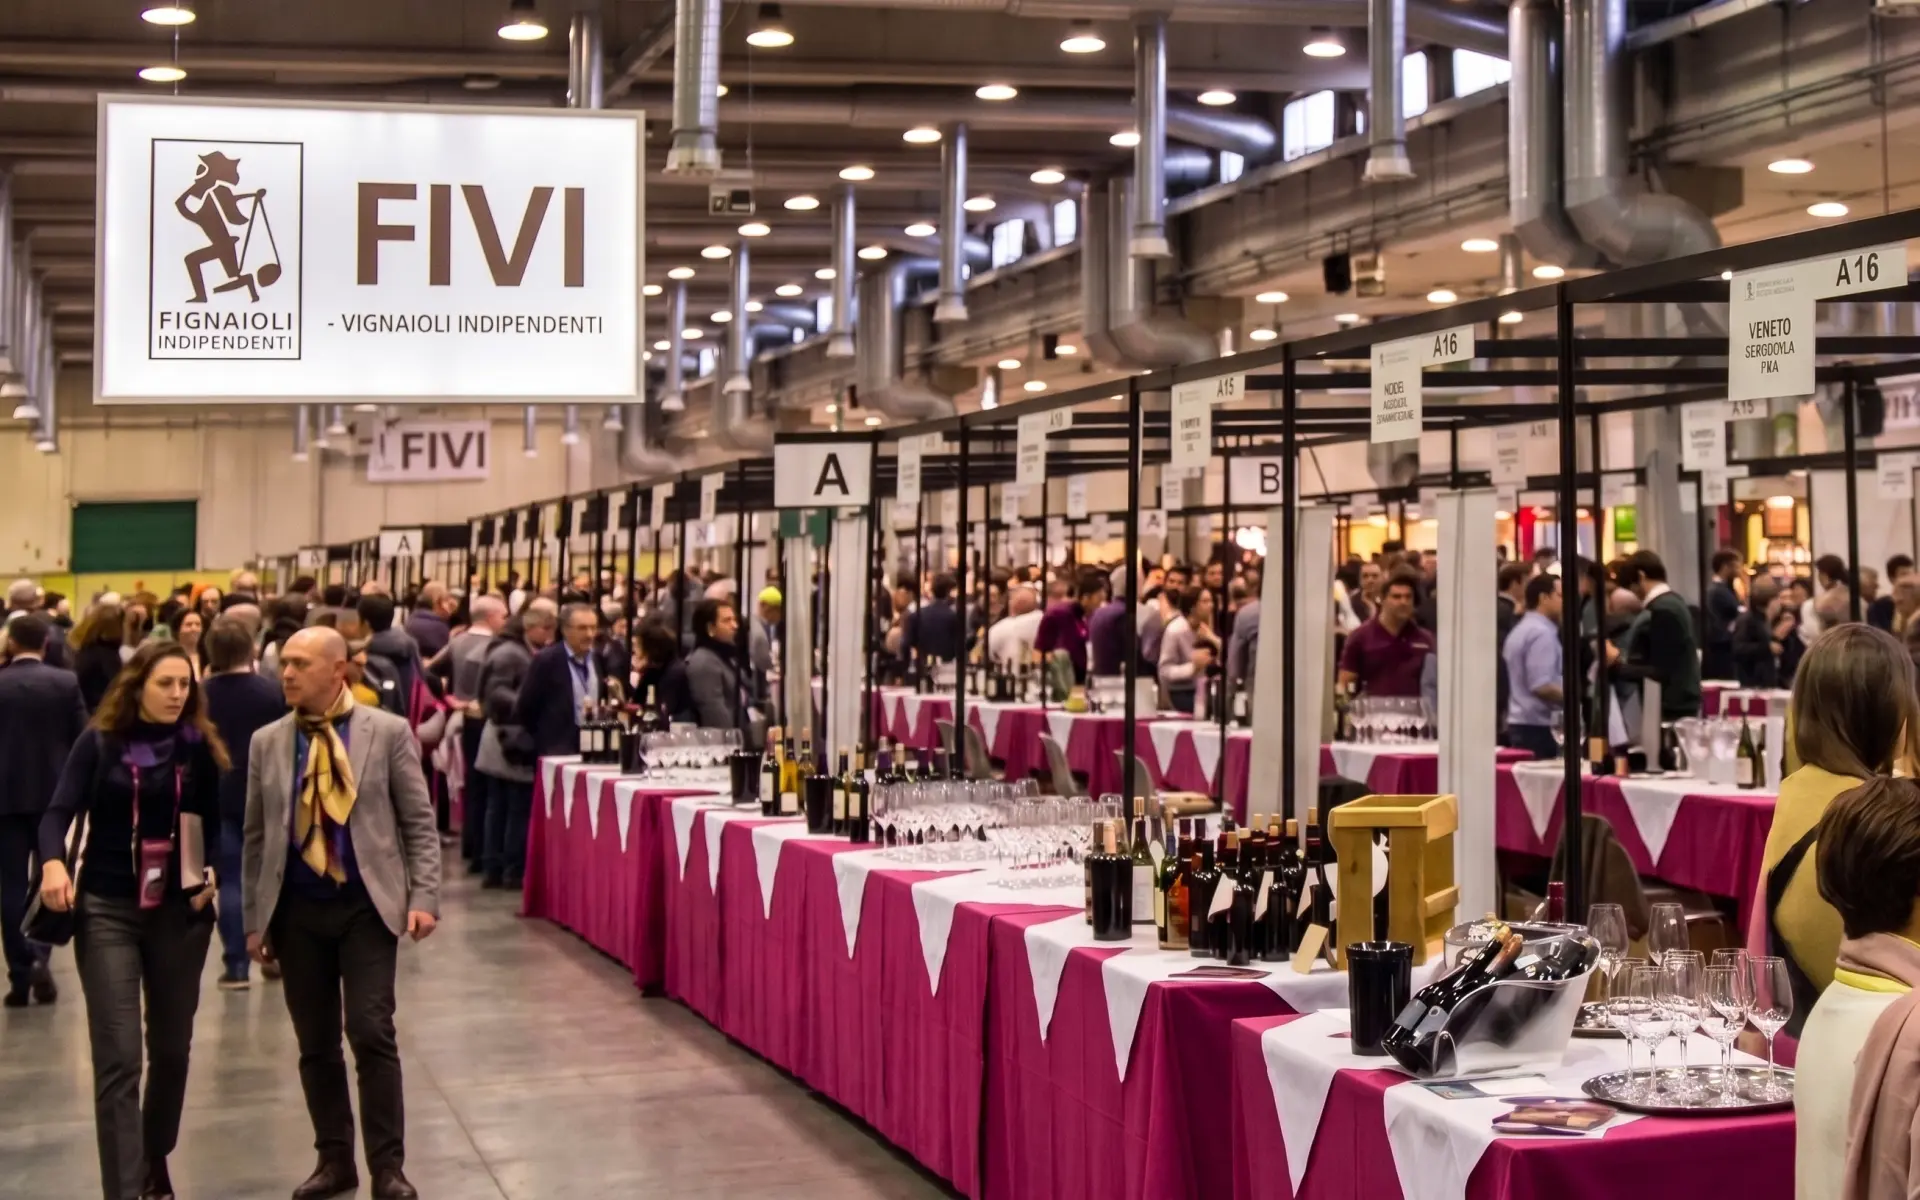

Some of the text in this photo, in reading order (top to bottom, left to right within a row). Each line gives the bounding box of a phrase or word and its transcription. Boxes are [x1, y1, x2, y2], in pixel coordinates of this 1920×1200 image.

[356, 181, 585, 288] FIVI
[1836, 252, 1879, 287] A16
[159, 311, 293, 331] FIGNAIOLI
[341, 313, 451, 334] VIGNAIOLI
[458, 314, 603, 335] INDIPENDENTI
[1749, 317, 1792, 340] VENETO
[158, 335, 293, 351] INDIPENDENTI
[1433, 332, 1458, 358] A16
[1217, 377, 1234, 397] A15
[401, 430, 486, 470] FIVI
[813, 452, 850, 496] A
[1260, 463, 1280, 494] B
[397, 535, 411, 551] A
